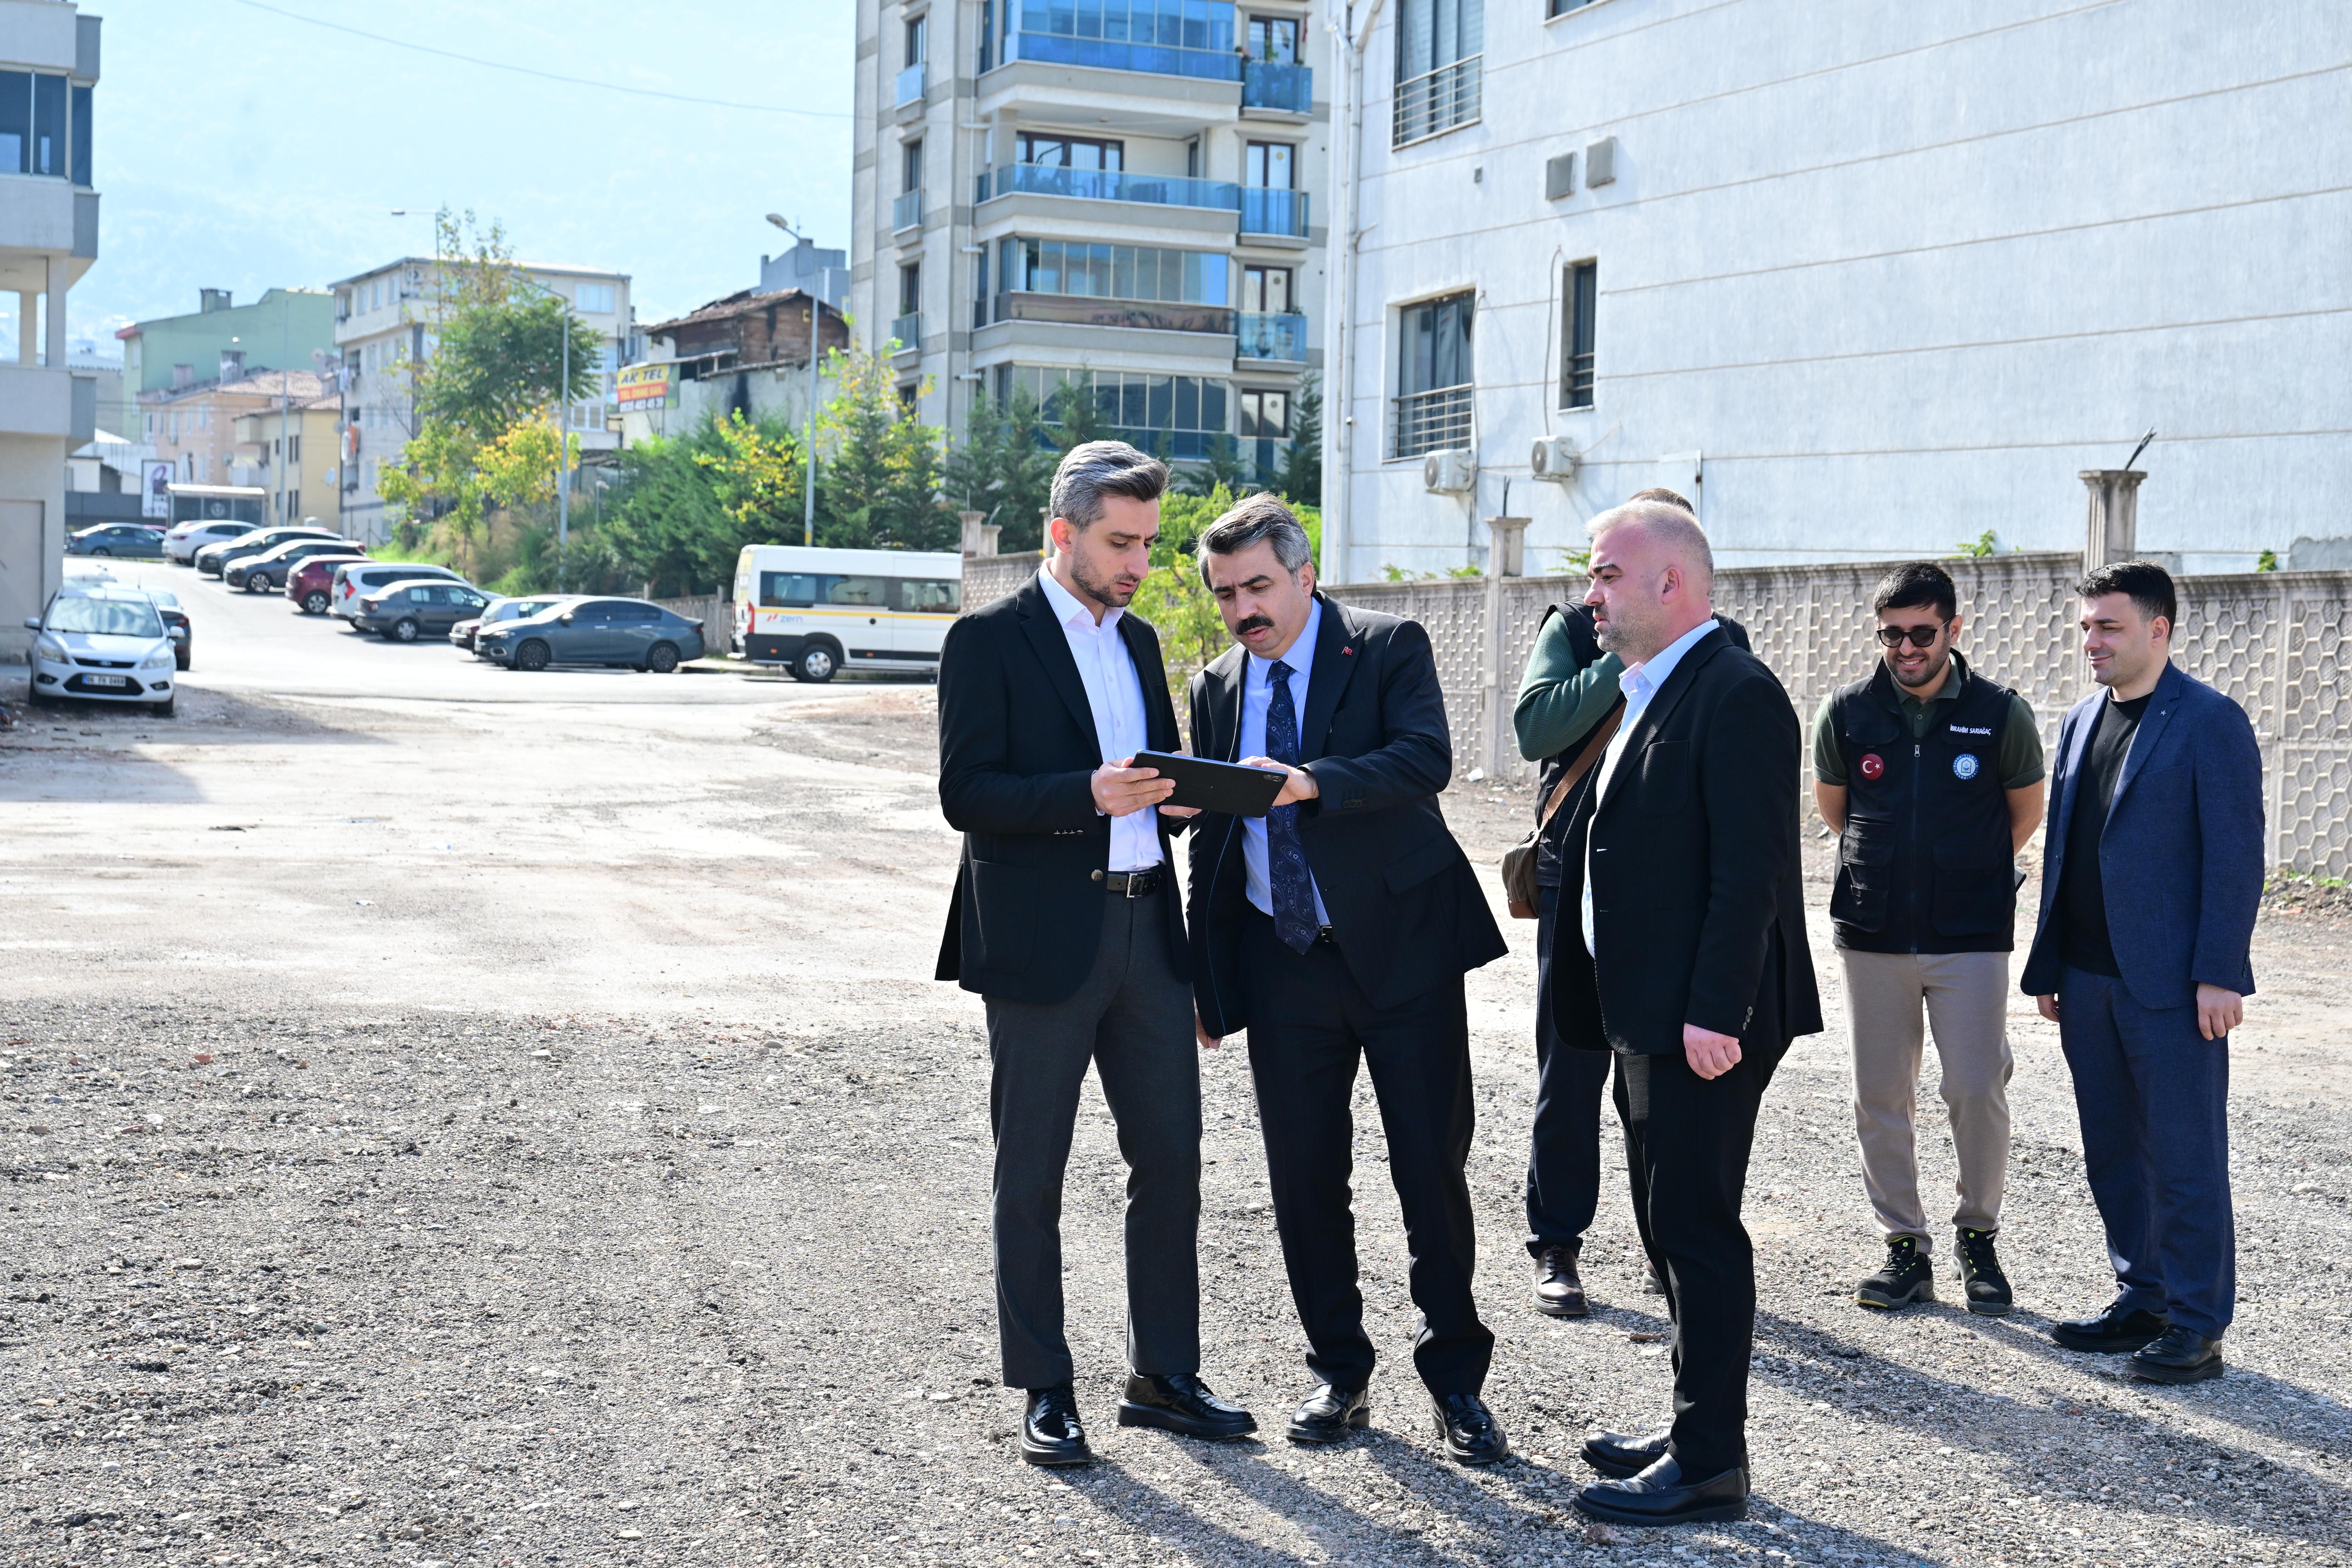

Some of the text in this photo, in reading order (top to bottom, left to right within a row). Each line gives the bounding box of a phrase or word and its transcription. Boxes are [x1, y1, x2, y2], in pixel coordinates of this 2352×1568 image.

[622, 368, 662, 384] AK TEL
[1950, 724, 1991, 736] İBRAHİM SARIAĞAÇ
[1953, 756, 1962, 767] BURSA
